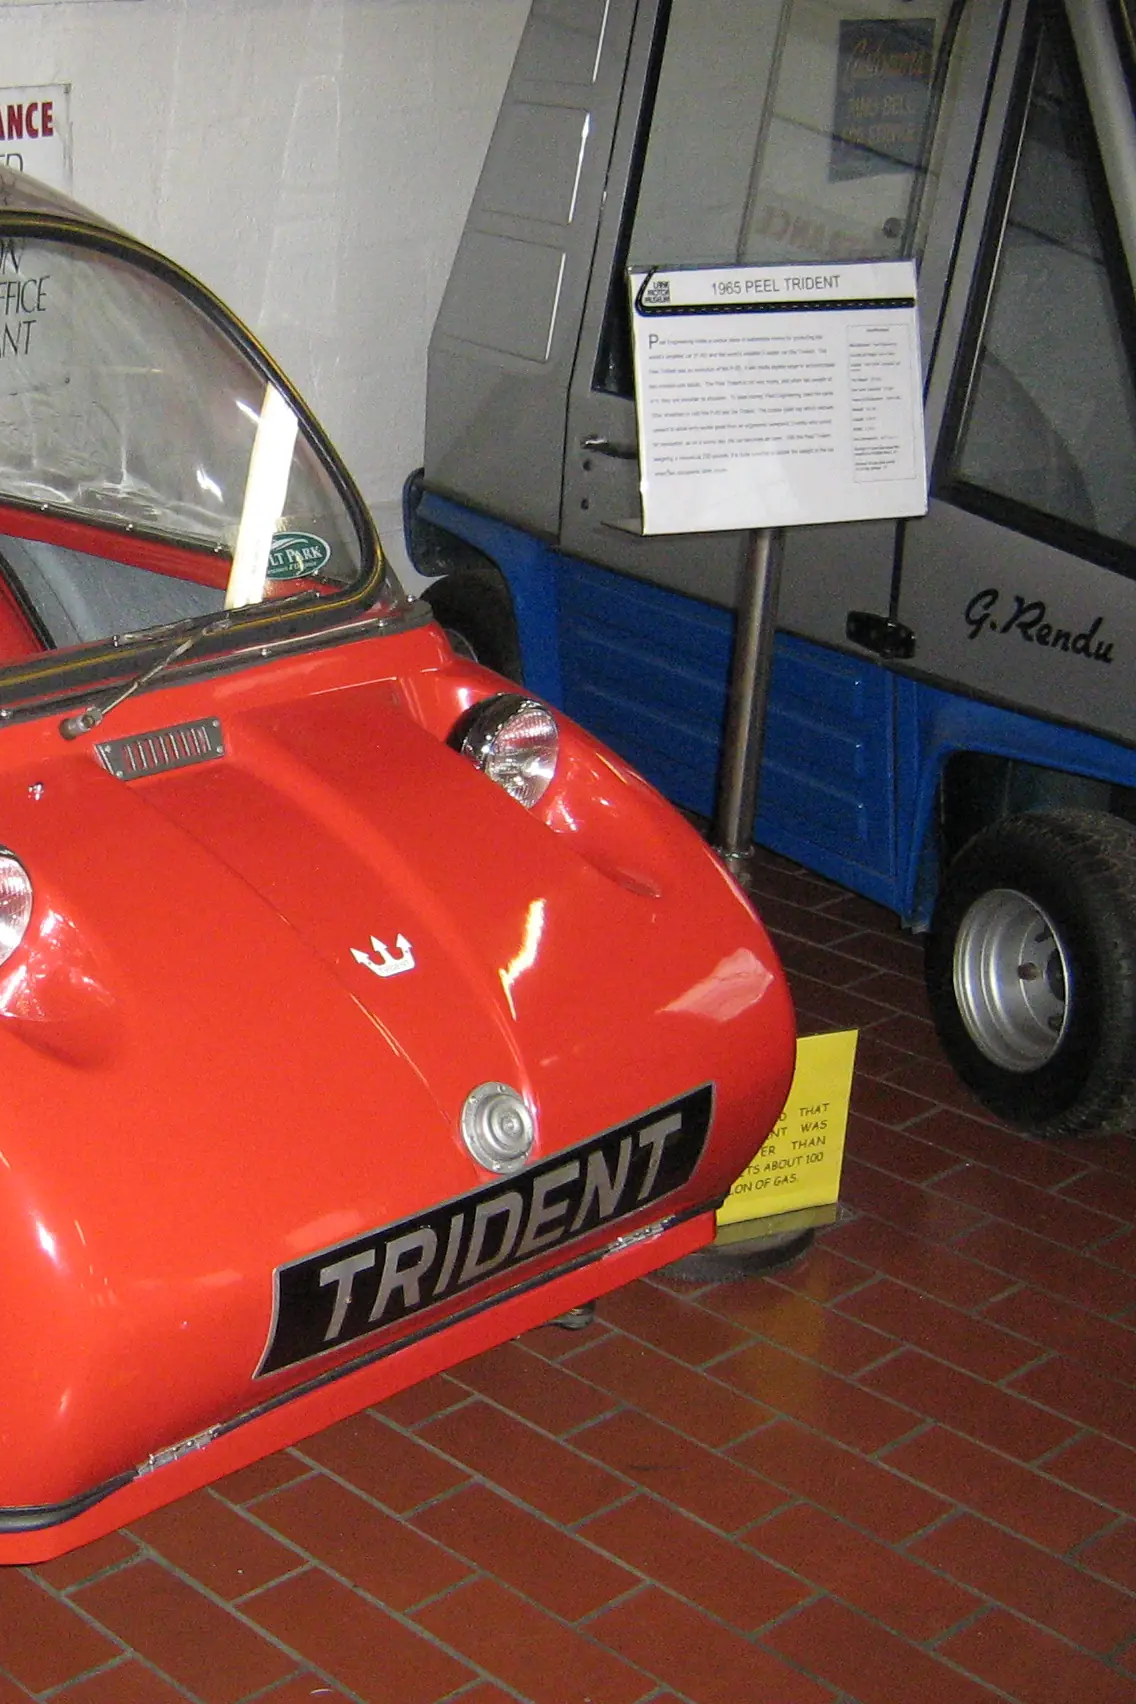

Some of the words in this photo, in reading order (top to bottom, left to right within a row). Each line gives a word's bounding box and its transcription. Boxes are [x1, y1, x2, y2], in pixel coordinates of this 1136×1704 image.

[711, 280, 742, 296] 1965
[745, 278, 780, 294] PEEL
[783, 274, 841, 291] TRIDENT
[799, 1102, 830, 1117] THAT
[800, 1119, 828, 1133] WAS
[791, 1135, 826, 1151] THAN
[764, 1155, 803, 1173] ABOUT
[805, 1151, 824, 1165] 100
[755, 1177, 771, 1191] OF
[319, 1112, 683, 1342] TRIDENT
